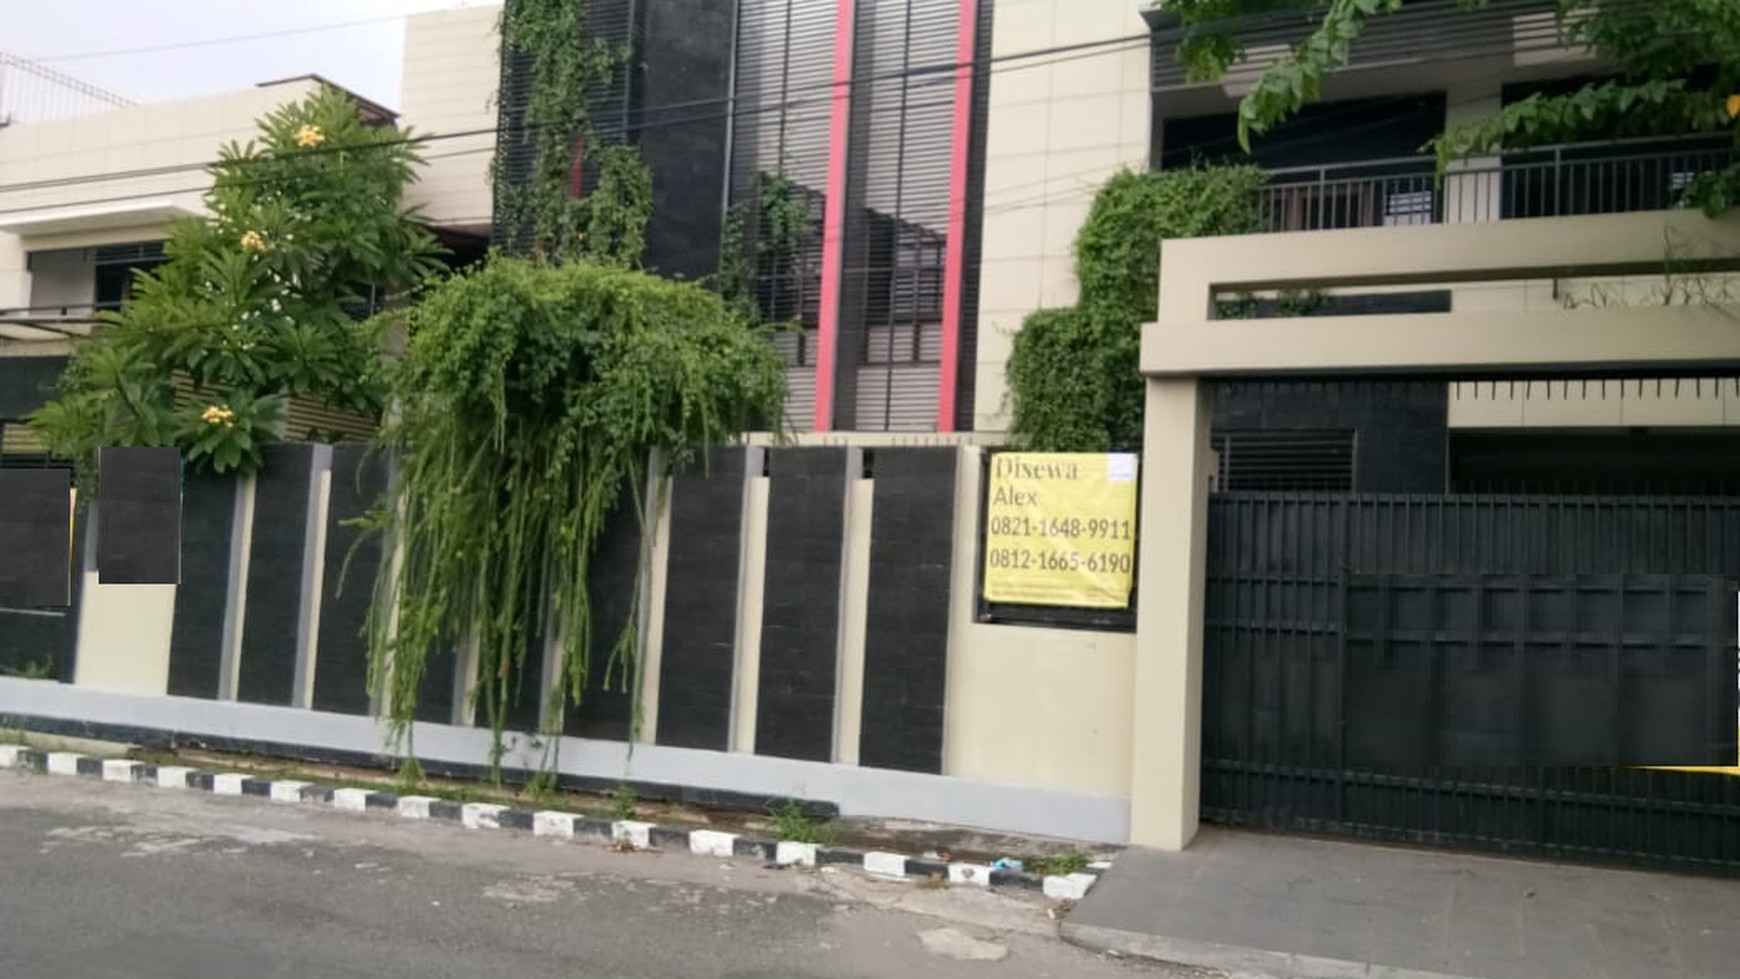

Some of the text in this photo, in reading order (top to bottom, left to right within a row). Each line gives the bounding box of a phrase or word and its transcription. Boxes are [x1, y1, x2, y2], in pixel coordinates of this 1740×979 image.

[996, 457, 1078, 479] Disewa
[993, 485, 1037, 506] Alex
[991, 516, 1131, 539] 0821-1648-9911
[990, 549, 1131, 573] 0812-1665-6190
